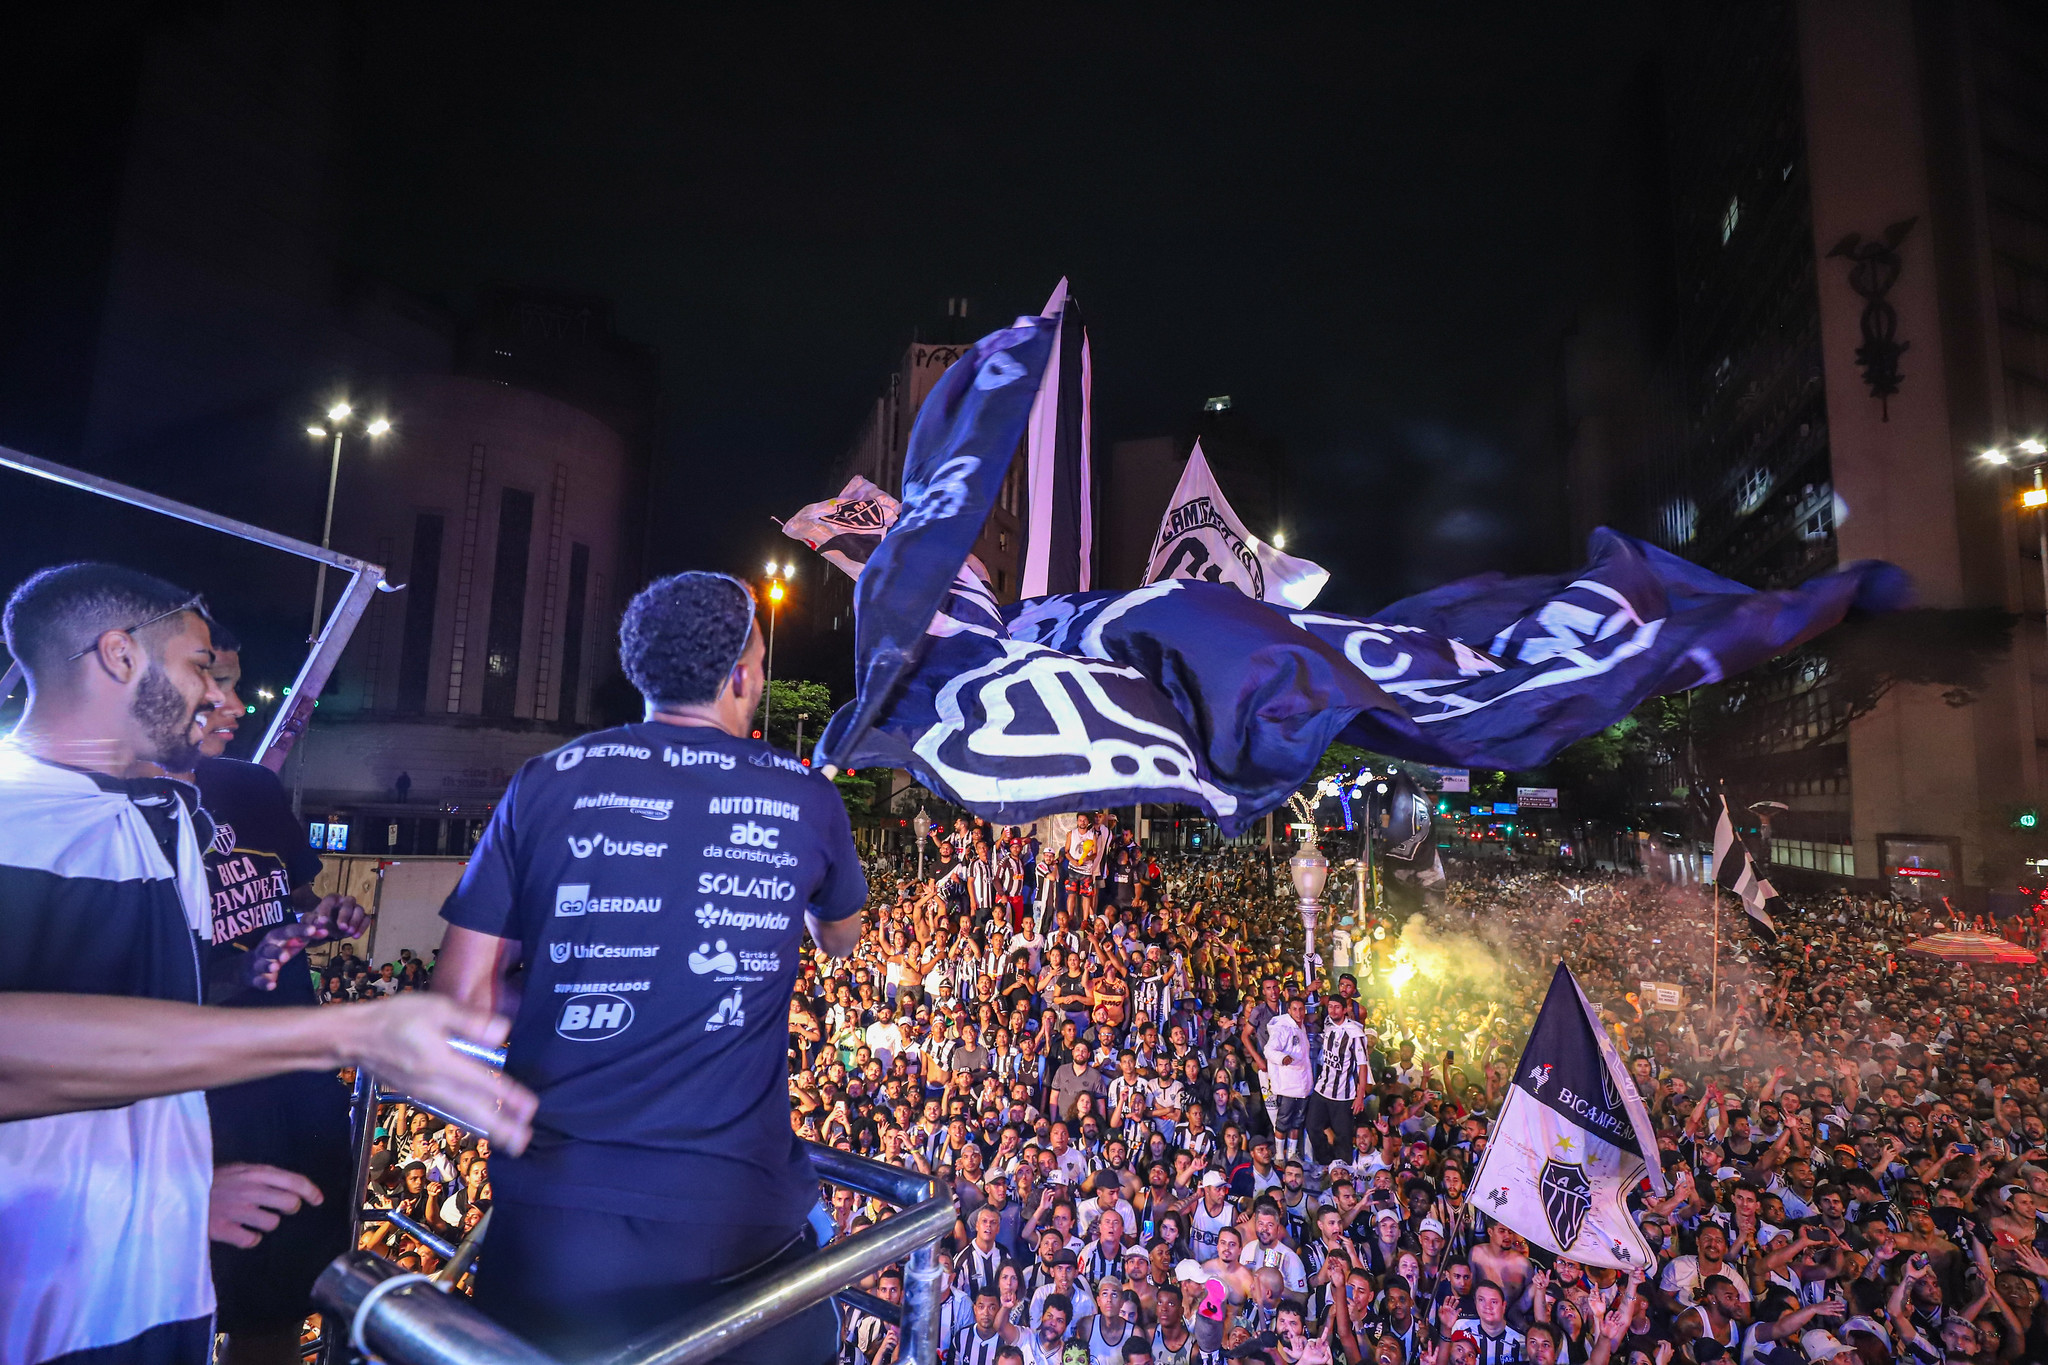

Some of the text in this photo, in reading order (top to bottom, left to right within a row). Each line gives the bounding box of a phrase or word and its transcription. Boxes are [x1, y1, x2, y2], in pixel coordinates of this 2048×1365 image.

[585, 744, 651, 760] BETANO
[573, 792, 674, 810] Multimarcas
[730, 821, 780, 849] abc
[603, 837, 668, 858] buser
[703, 844, 798, 868] da construção
[217, 856, 258, 887] BICA
[586, 897, 662, 913] GERDAU
[719, 908, 790, 931] hapvida
[574, 944, 660, 958] UniCesumar
[559, 1003, 627, 1030] BH
